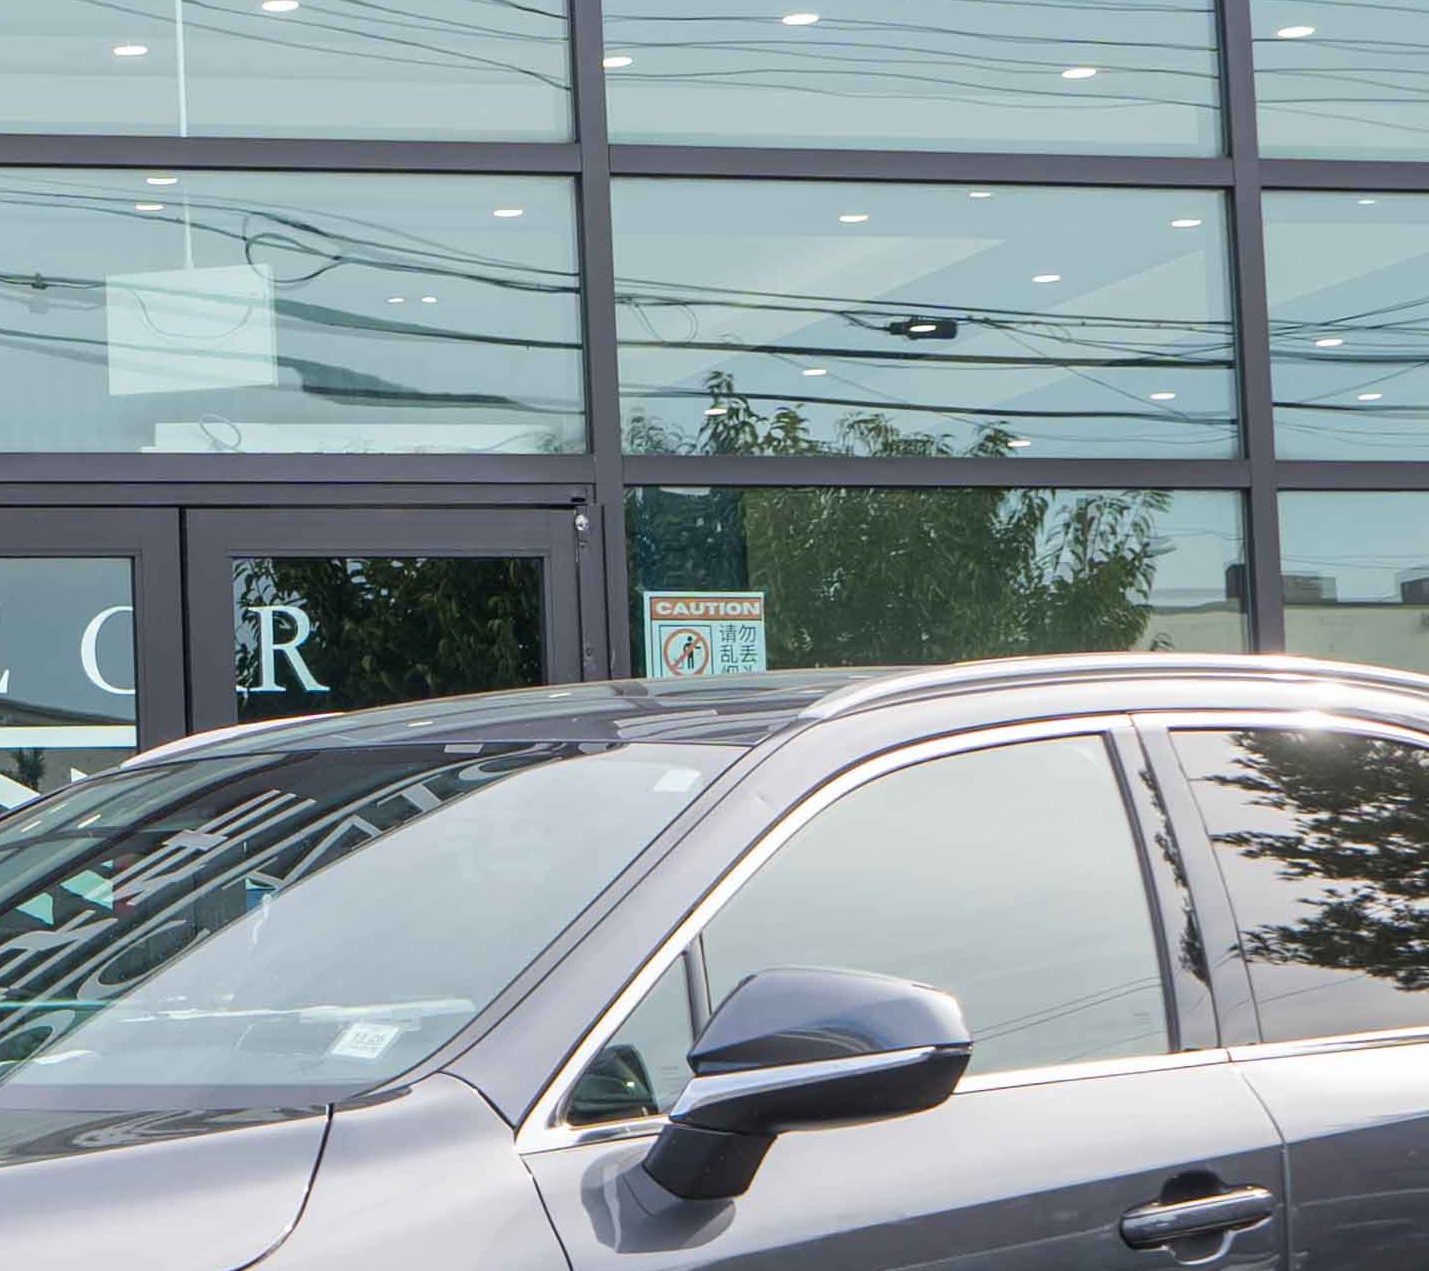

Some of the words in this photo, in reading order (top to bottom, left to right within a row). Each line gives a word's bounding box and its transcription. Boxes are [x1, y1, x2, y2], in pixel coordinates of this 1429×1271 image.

[655, 601, 761, 617] CAUTION
[720, 622, 757, 644] 请勿
[81, 604, 331, 695] CR
[719, 644, 758, 664] 乱丢
